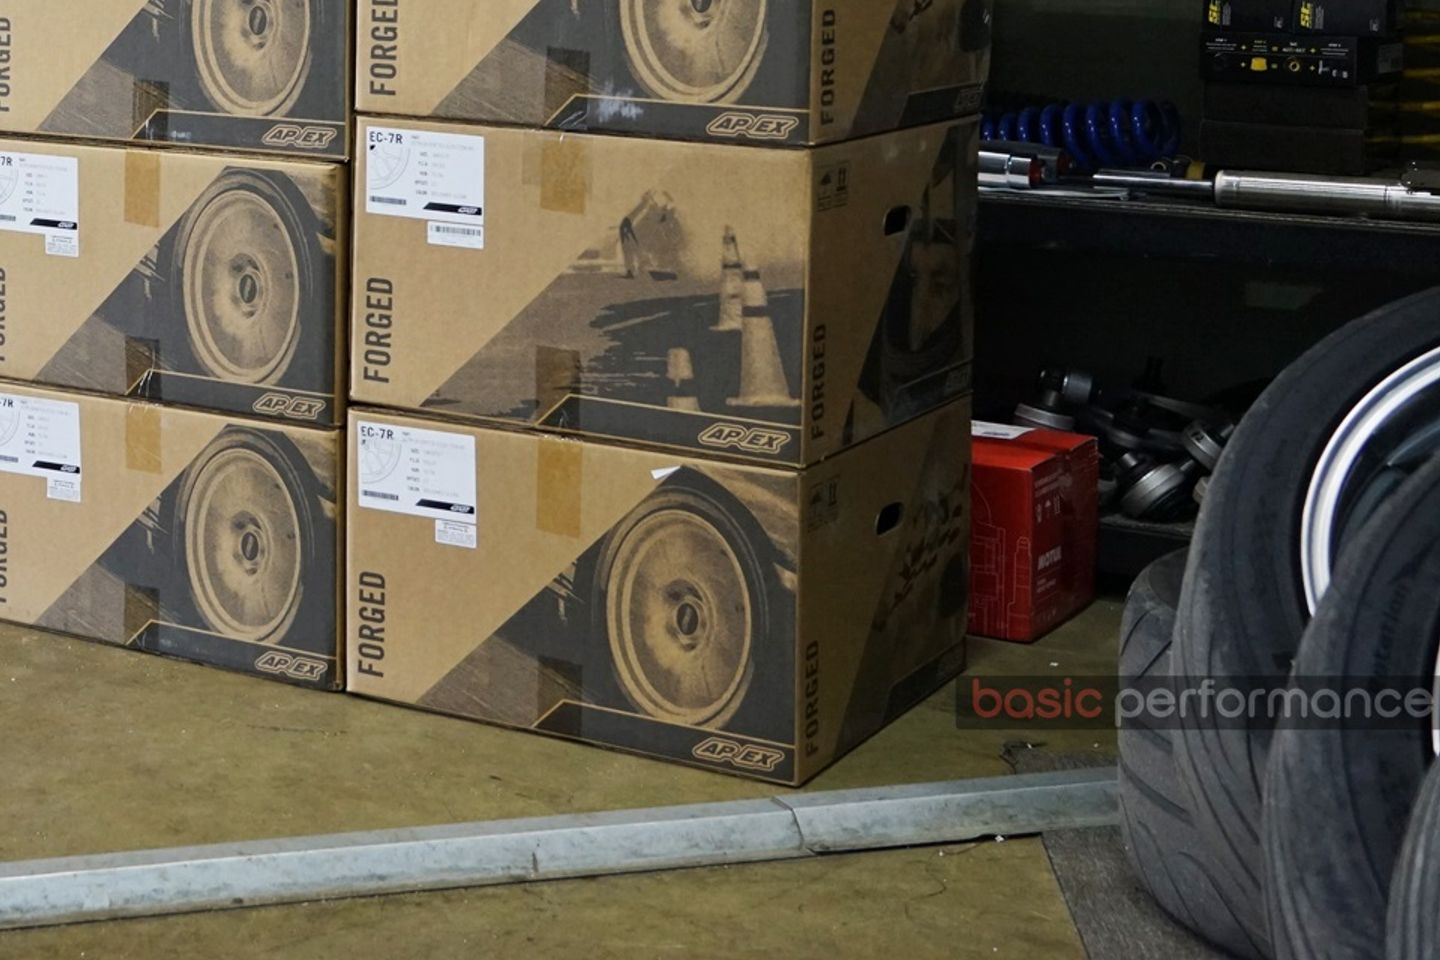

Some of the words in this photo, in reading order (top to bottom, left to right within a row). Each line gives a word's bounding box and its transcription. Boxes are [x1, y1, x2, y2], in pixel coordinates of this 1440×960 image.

[819, 8, 837, 126] FORGED
[369, 131, 403, 144] EC-7R
[364, 276, 394, 383] FORGED
[811, 323, 827, 440] FORGED
[361, 426, 394, 440] EC-7R
[358, 570, 386, 679] FORGED
[806, 640, 820, 757] FORGED
